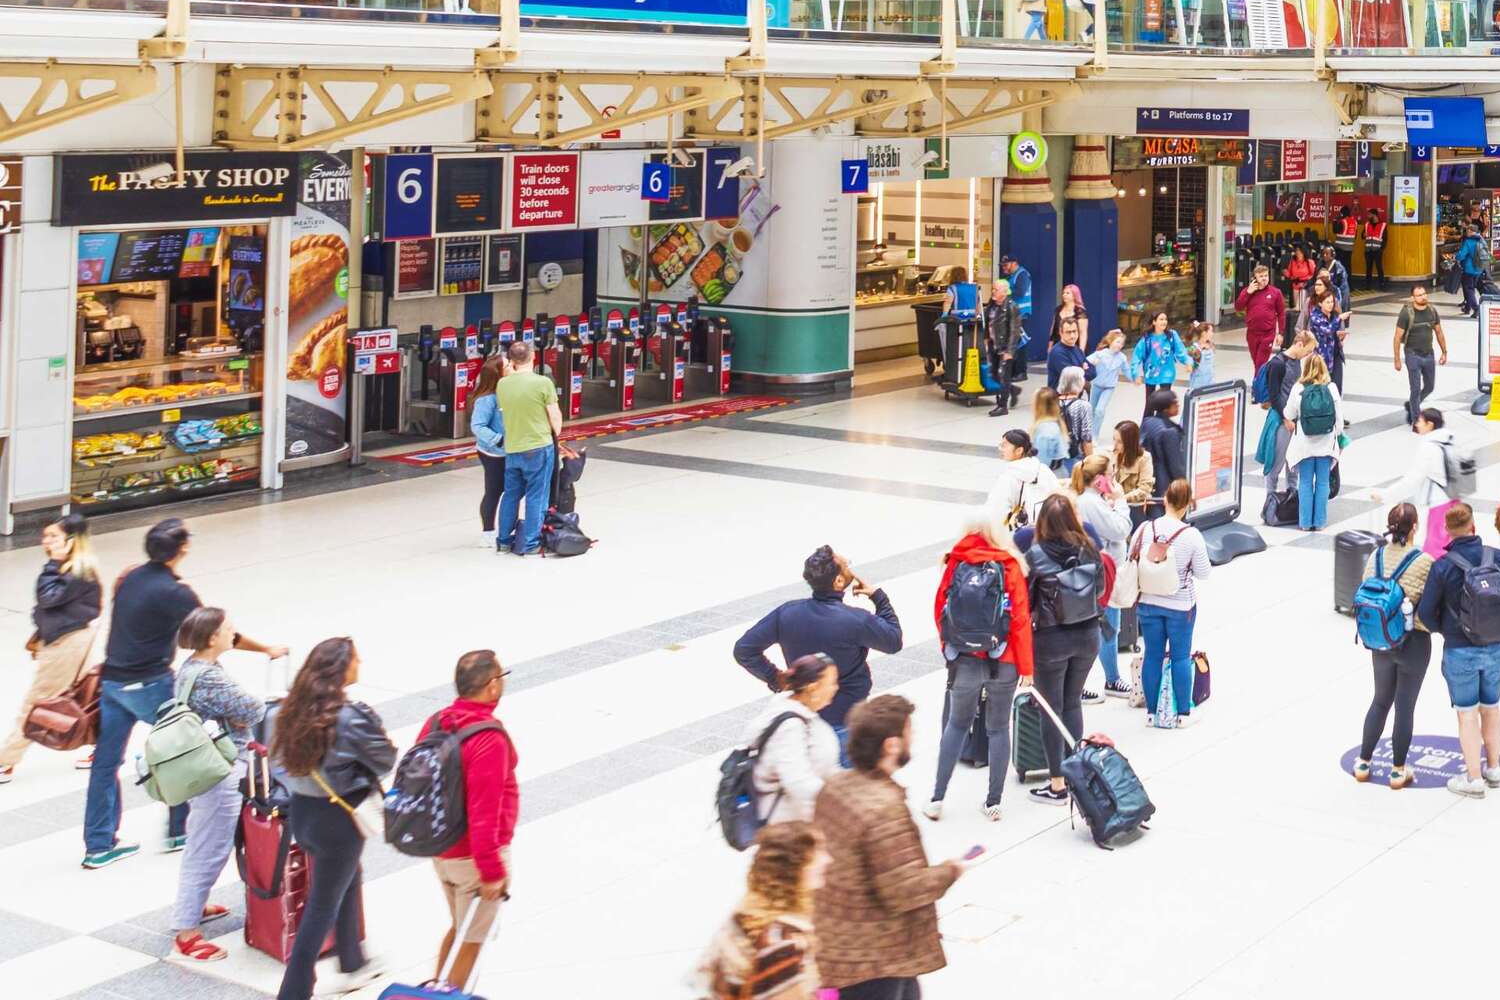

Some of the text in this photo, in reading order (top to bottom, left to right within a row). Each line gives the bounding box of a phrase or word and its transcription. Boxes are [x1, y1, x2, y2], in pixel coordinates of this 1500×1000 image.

[1169, 111, 1204, 119] Platforms
[1206, 112, 1211, 120] 8
[1223, 113, 1232, 121] 17
[1144, 137, 1198, 155] MI CASA
[1360, 141, 1368, 159] 9
[1150, 156, 1193, 166] BURRITOS
[1217, 151, 1244, 159] CASA
[520, 163, 570, 174] Train doors
[714, 159, 735, 190] 7
[89, 174, 117, 191] The
[217, 167, 290, 188] SHOP
[520, 175, 561, 185] will close
[649, 170, 662, 192] 6
[849, 165, 861, 186] 7
[397, 167, 423, 204] 6
[520, 185, 569, 197] 30 seconds
[588, 184, 640, 194] greateranglia
[520, 198, 549, 208] before
[520, 209, 563, 221] departure
[925, 224, 945, 240] healthy
